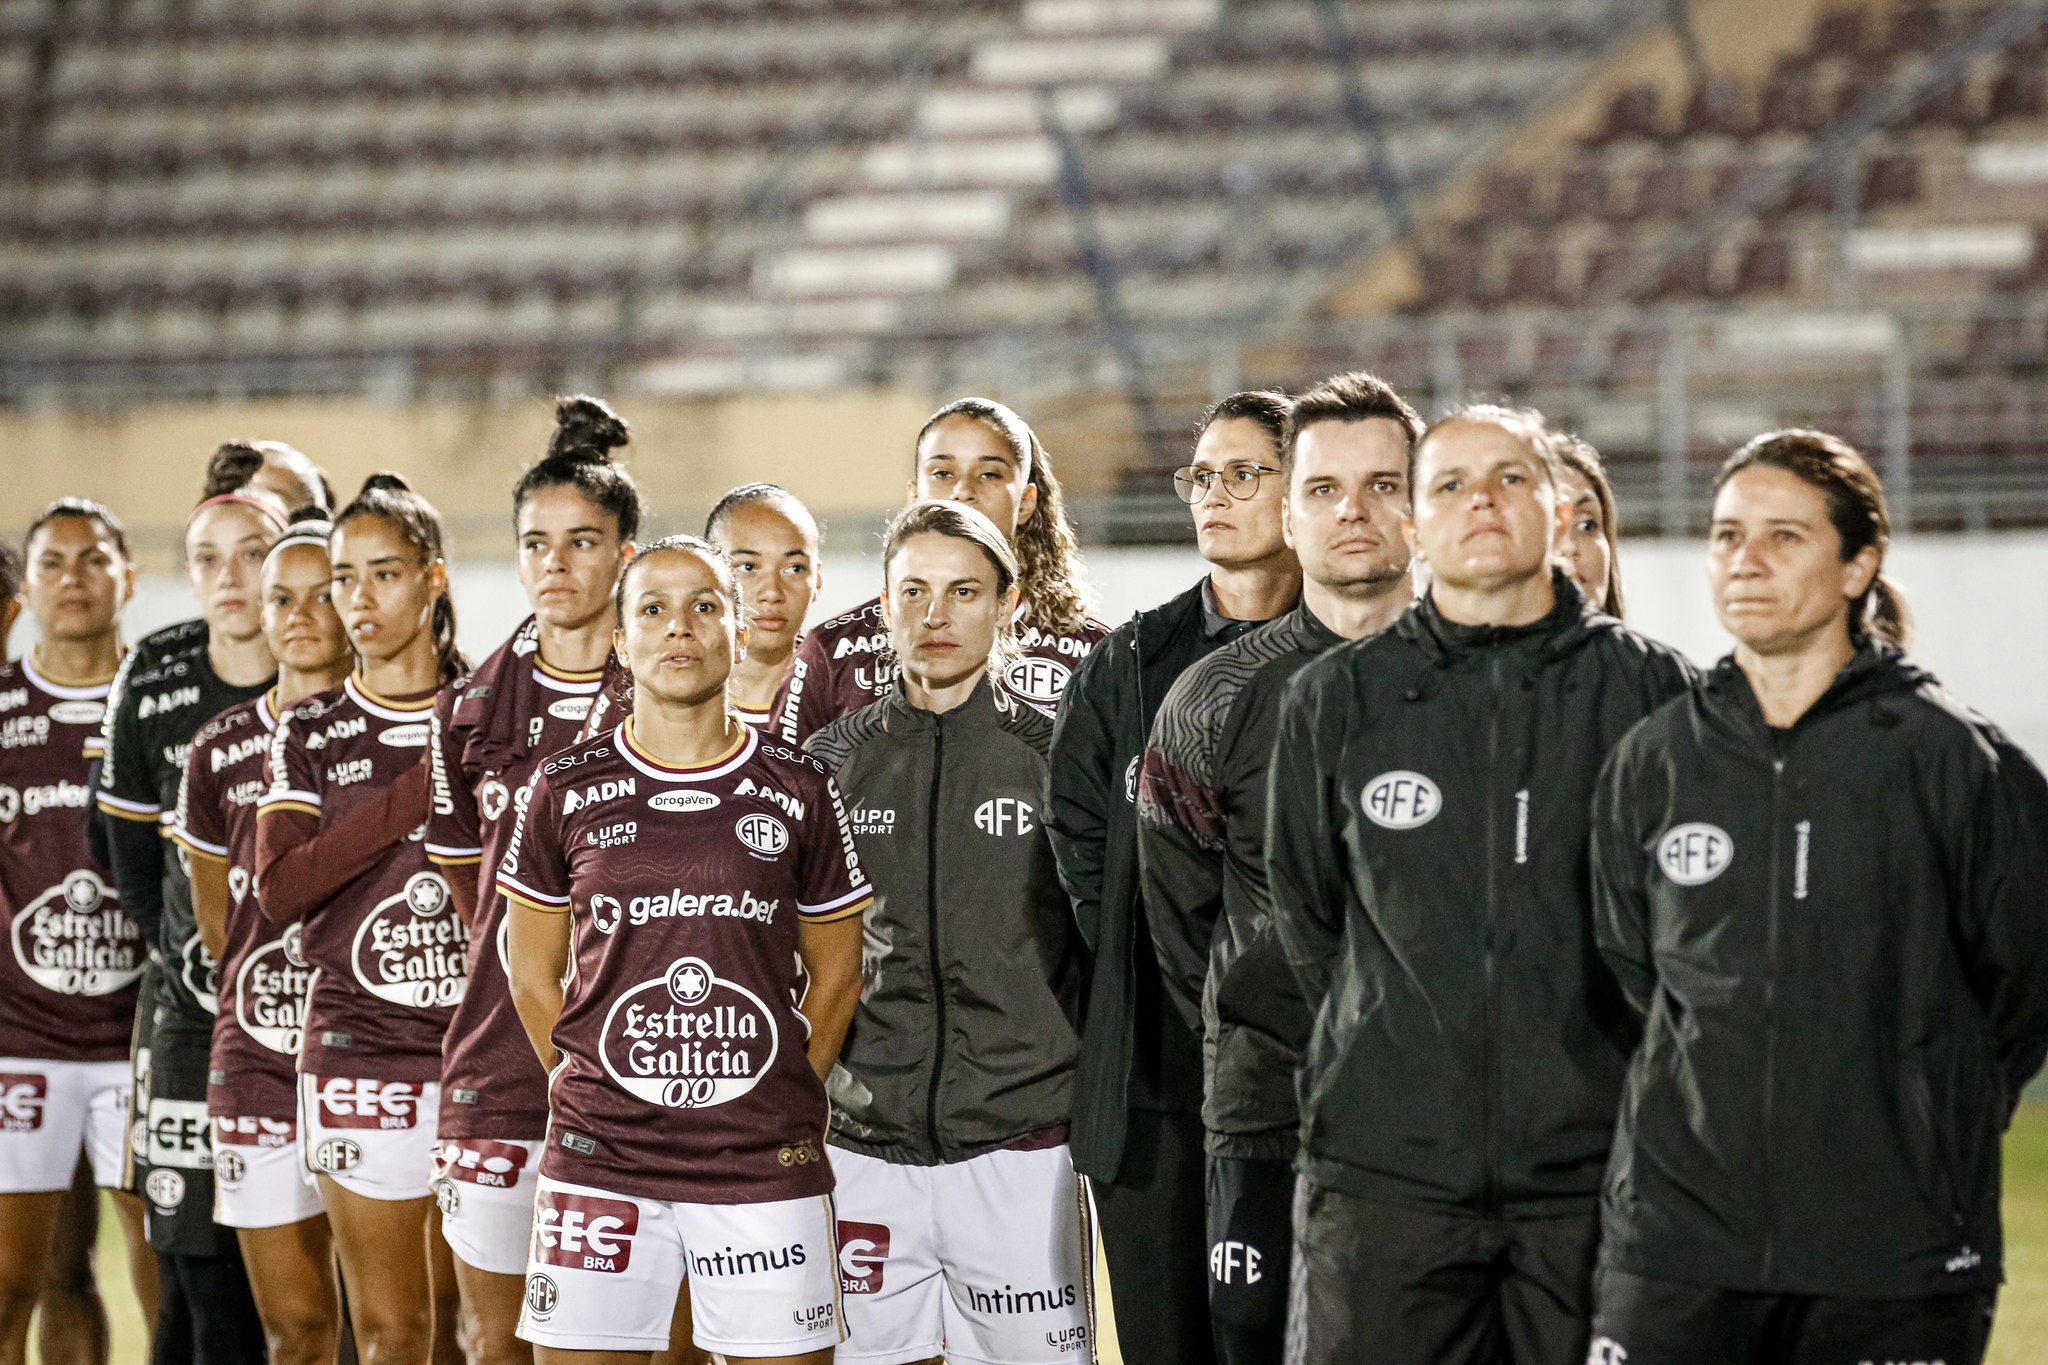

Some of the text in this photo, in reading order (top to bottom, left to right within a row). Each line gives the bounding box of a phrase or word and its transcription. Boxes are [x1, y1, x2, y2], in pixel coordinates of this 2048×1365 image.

[825, 604, 884, 629] estre
[854, 634, 888, 655] AD
[855, 665, 901, 690] LUP
[1011, 664, 1064, 690] AFE
[554, 704, 590, 714] Droga
[779, 657, 808, 745] nimed
[0, 715, 50, 735] UPO
[431, 715, 454, 815] Unimed
[544, 747, 610, 775] estre
[761, 745, 825, 774] estre
[585, 777, 637, 807] ADN
[654, 794, 713, 807] DrogaVen
[758, 786, 805, 821] ADN
[1371, 780, 1429, 818] AFE
[852, 825, 894, 834] SPORT
[853, 809, 895, 823] UPO
[974, 798, 1033, 836] AFE
[587, 821, 637, 845] LUPO
[600, 834, 637, 849] SPORT
[742, 819, 781, 848] AFE
[827, 776, 865, 888] Unimed
[1667, 832, 1720, 875] AFE
[629, 888, 779, 925] galera.bet
[29, 906, 140, 939] Estrella
[33, 936, 134, 969] Galicia
[379, 945, 468, 983] Galici
[251, 962, 309, 995] Estr
[623, 1003, 758, 1039] Estrella
[629, 1040, 751, 1076] Galicia
[323, 1077, 413, 1116] CEC
[380, 1116, 409, 1129] BRA
[319, 1141, 359, 1172] AFE
[477, 1171, 506, 1187] BRA
[537, 1208, 625, 1256] CEC
[584, 1256, 616, 1271] BRA
[690, 1243, 806, 1276] Intimus
[1210, 1241, 1262, 1284] AFE
[528, 1277, 555, 1311] AFE
[967, 1285, 1076, 1314] Intimus
[793, 1304, 833, 1325] LUPO
[808, 1317, 833, 1331] SPORT
[1046, 1326, 1086, 1347] LUPO
[1060, 1340, 1087, 1352] SPORT
